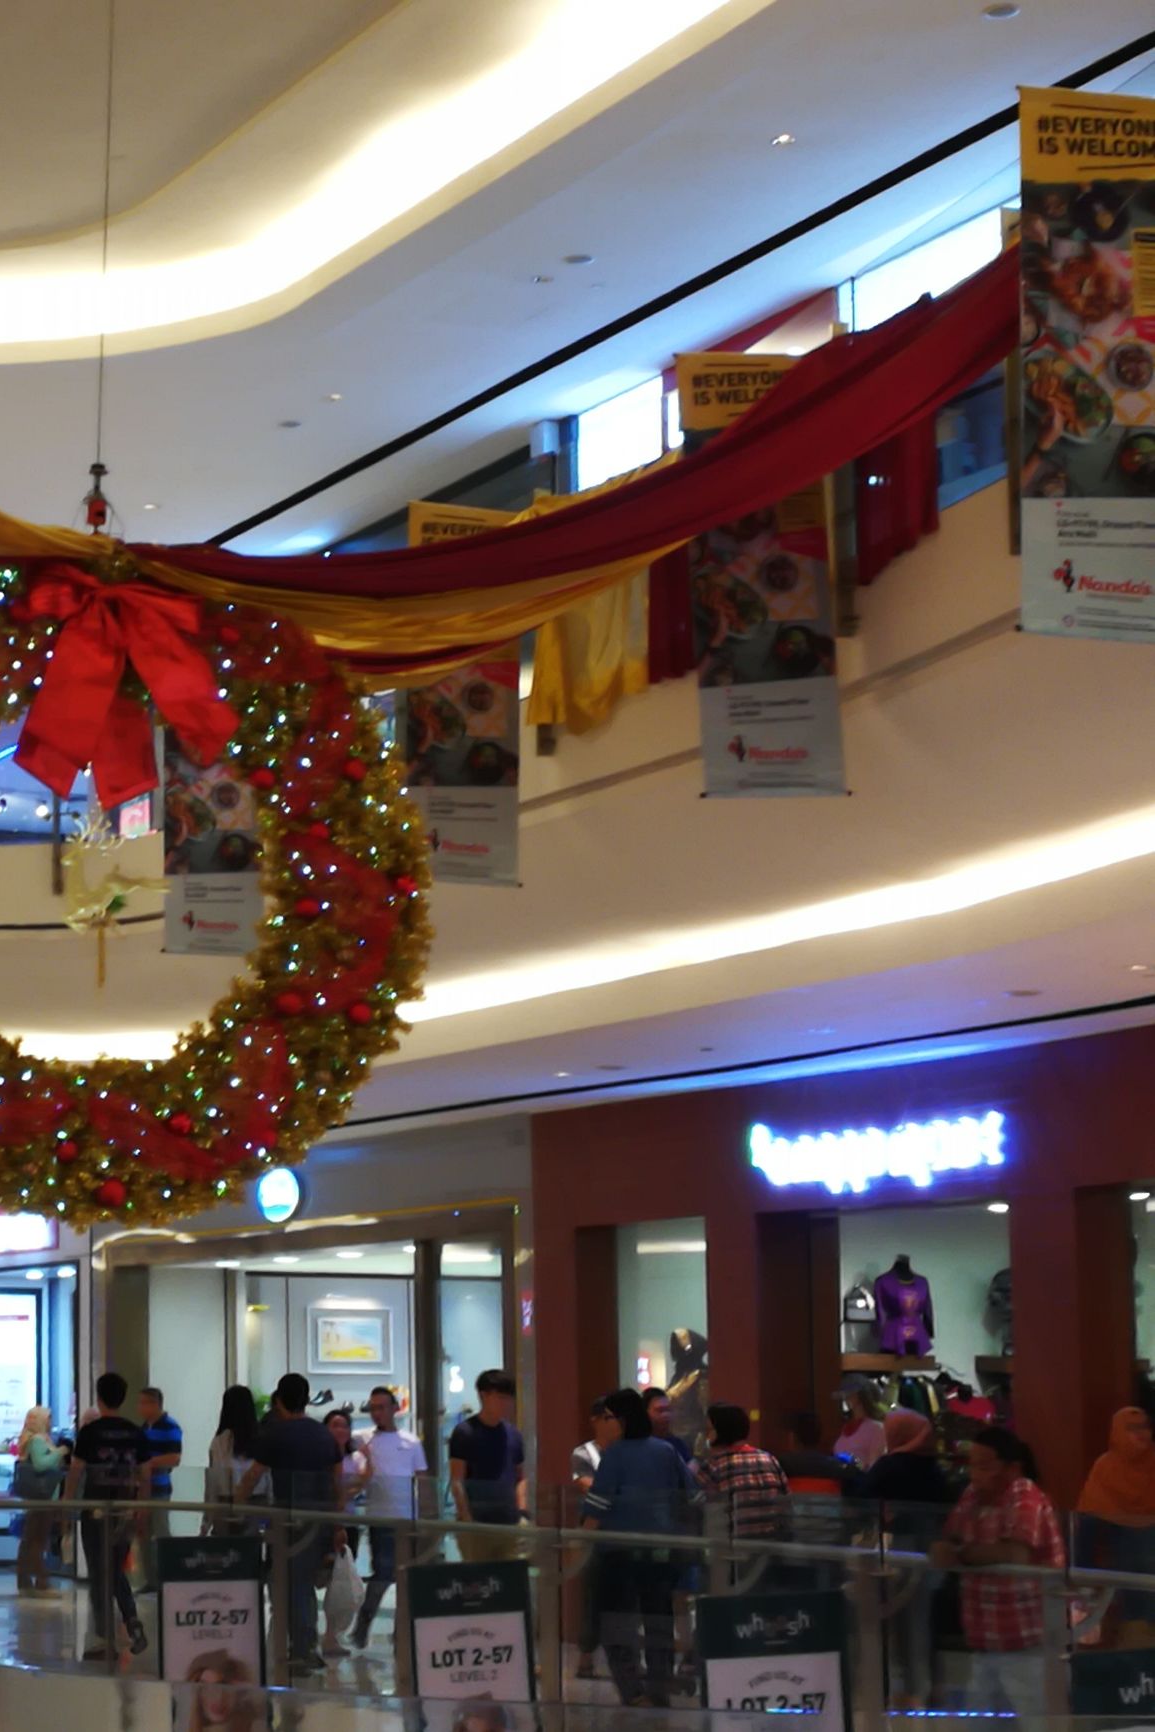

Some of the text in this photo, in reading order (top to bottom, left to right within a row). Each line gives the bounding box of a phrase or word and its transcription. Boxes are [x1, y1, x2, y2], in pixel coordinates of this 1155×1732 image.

[1038, 136, 1059, 155] IS
[693, 390, 711, 406] IS
[437, 1577, 500, 1600] whsh
[175, 1609, 249, 1627] LOT 2-57
[735, 1609, 811, 1639] whsh
[431, 1645, 513, 1669] LOT 2-57
[449, 1670, 488, 1683] LEVEL
[776, 1693, 826, 1712] 2-57
